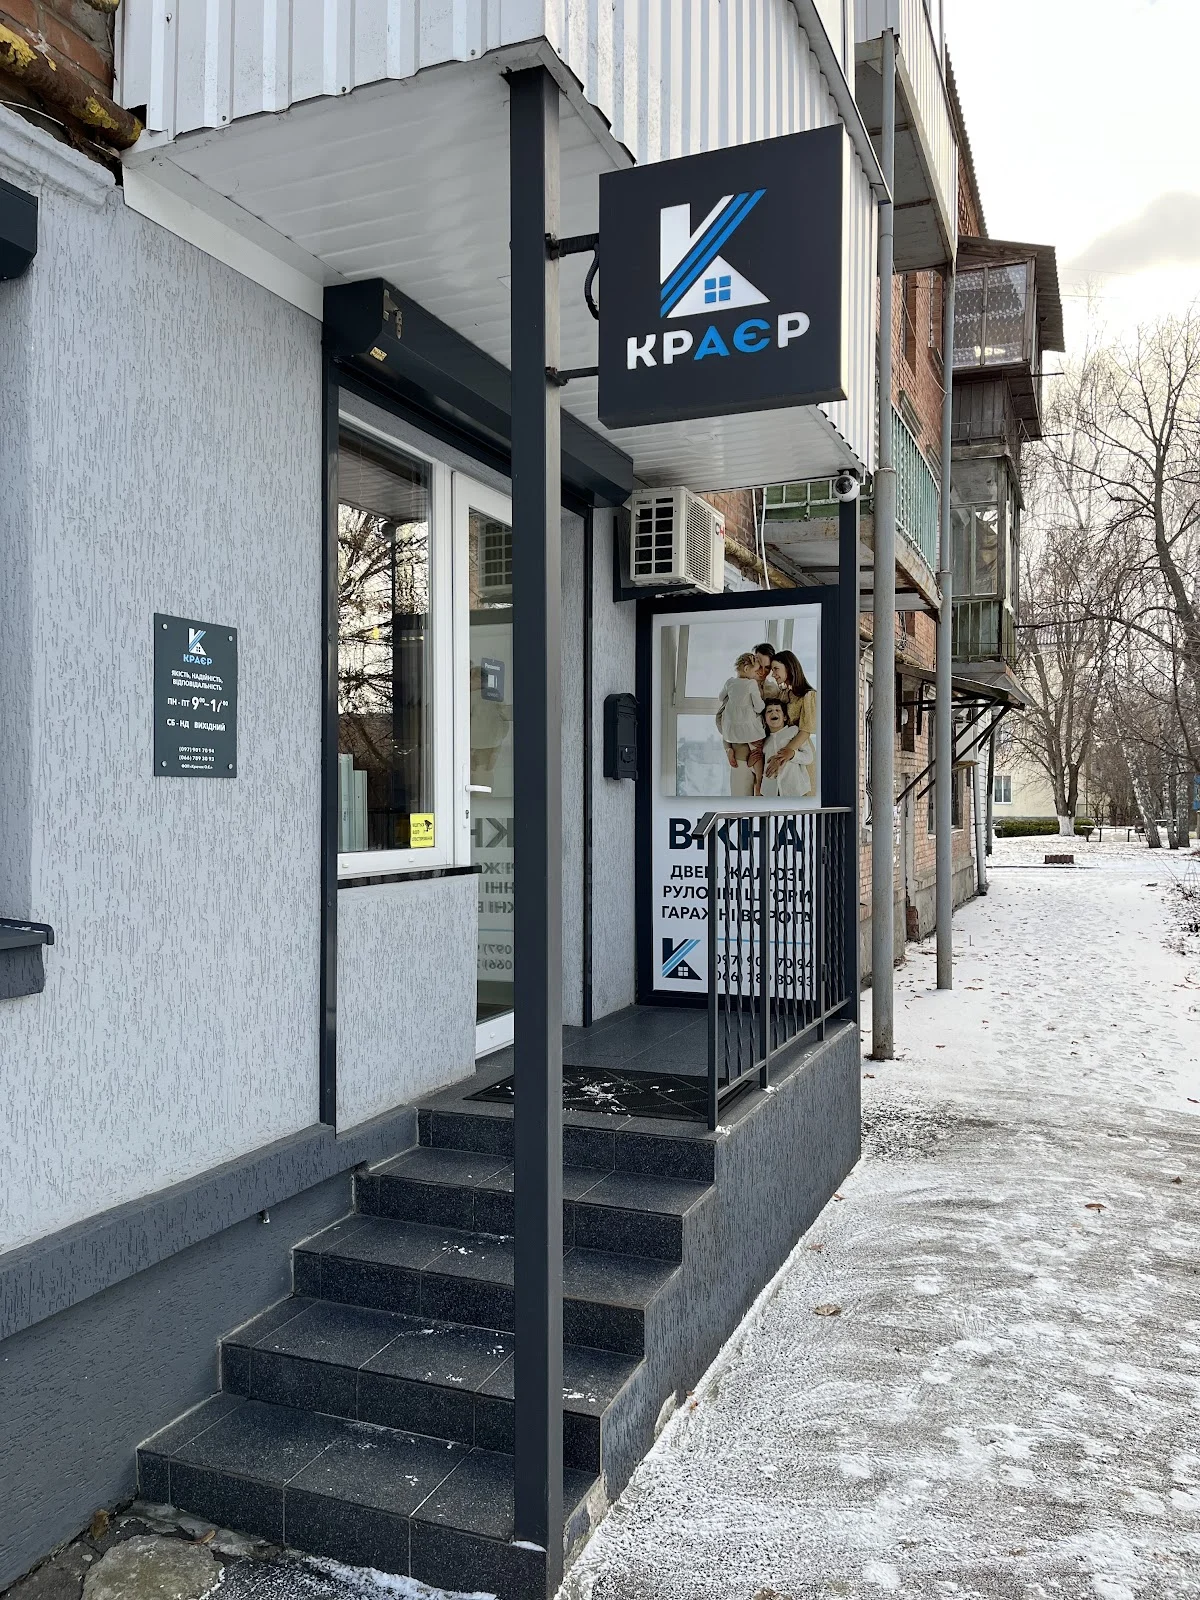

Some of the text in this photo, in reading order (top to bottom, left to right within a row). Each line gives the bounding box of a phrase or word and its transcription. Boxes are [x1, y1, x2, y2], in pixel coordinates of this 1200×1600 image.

[627, 311, 811, 370] КРАЄР
[183, 654, 212, 666] КРАЄР
[172, 679, 222, 691] ВІДПОВІДАЛЬНІСТЬ
[194, 721, 226, 732] ВИХІДНИЙ
